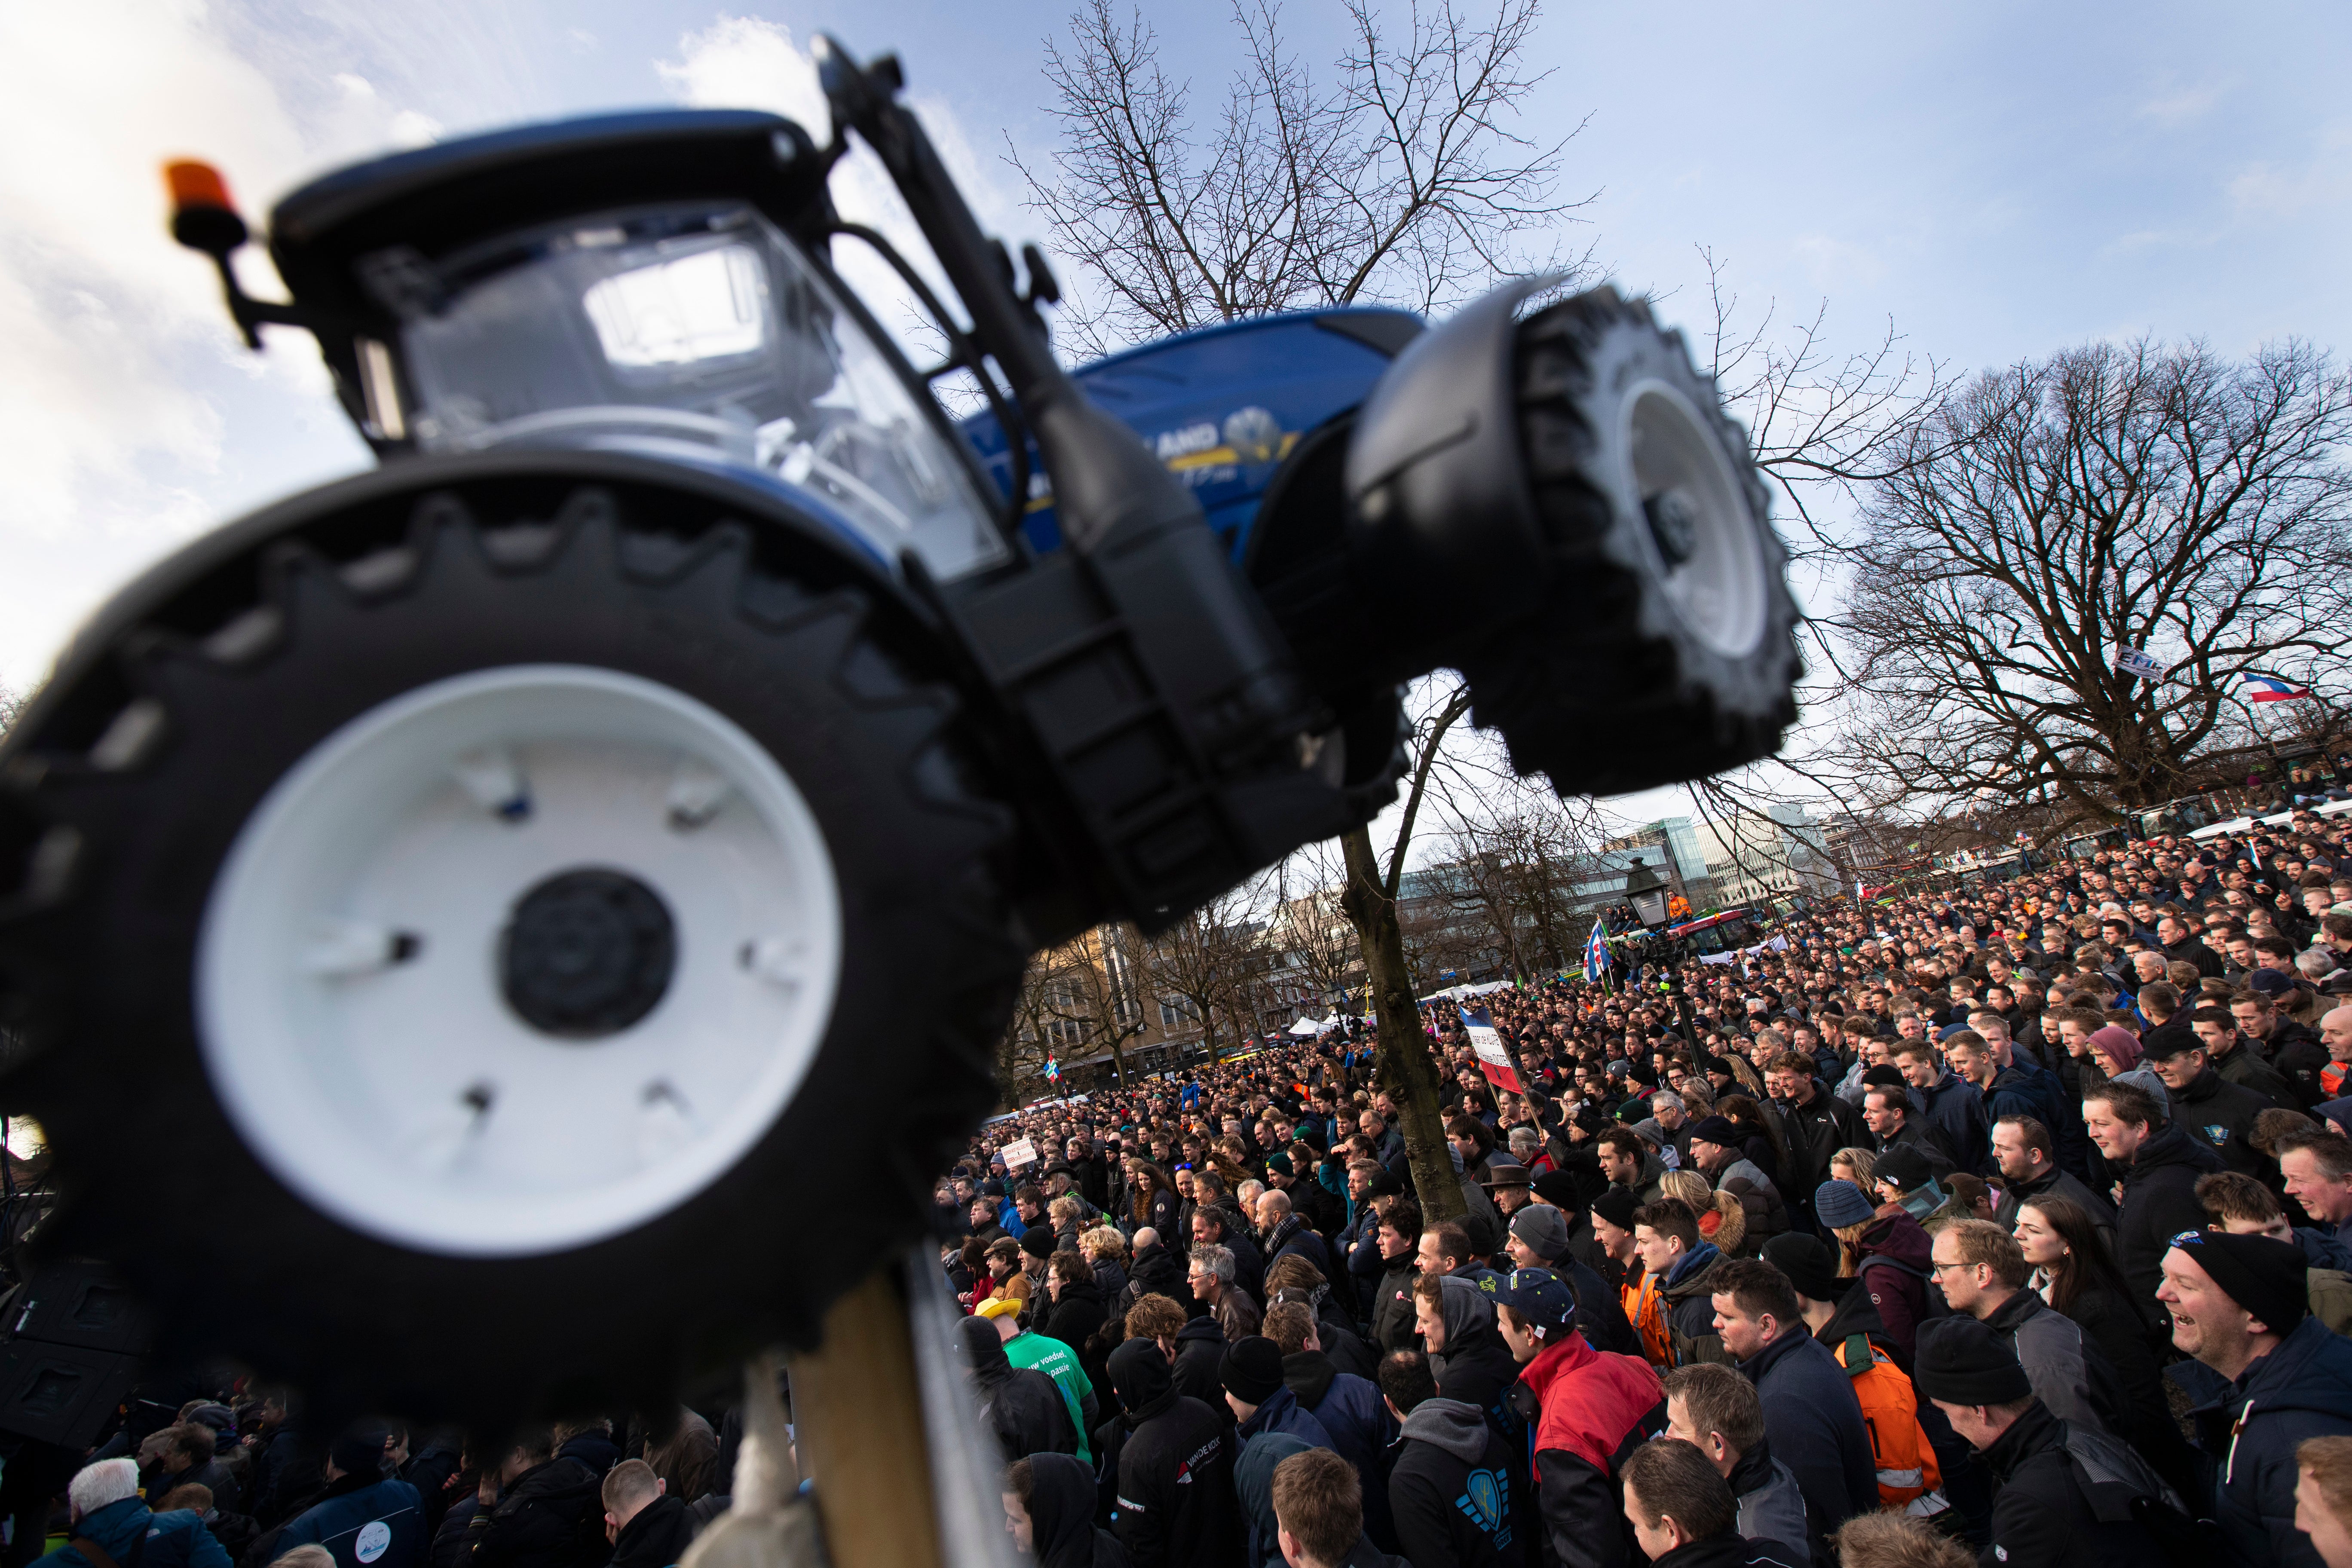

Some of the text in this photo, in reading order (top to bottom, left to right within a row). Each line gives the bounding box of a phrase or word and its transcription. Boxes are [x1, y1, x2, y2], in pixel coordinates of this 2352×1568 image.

[1481, 1034, 1486, 1044] de
[1487, 1034, 1499, 1045] KLOTE
[1040, 1350, 1067, 1365] voedsel,
[1050, 1363, 1069, 1378] passie
[1208, 1436, 1220, 1451] KOLK
